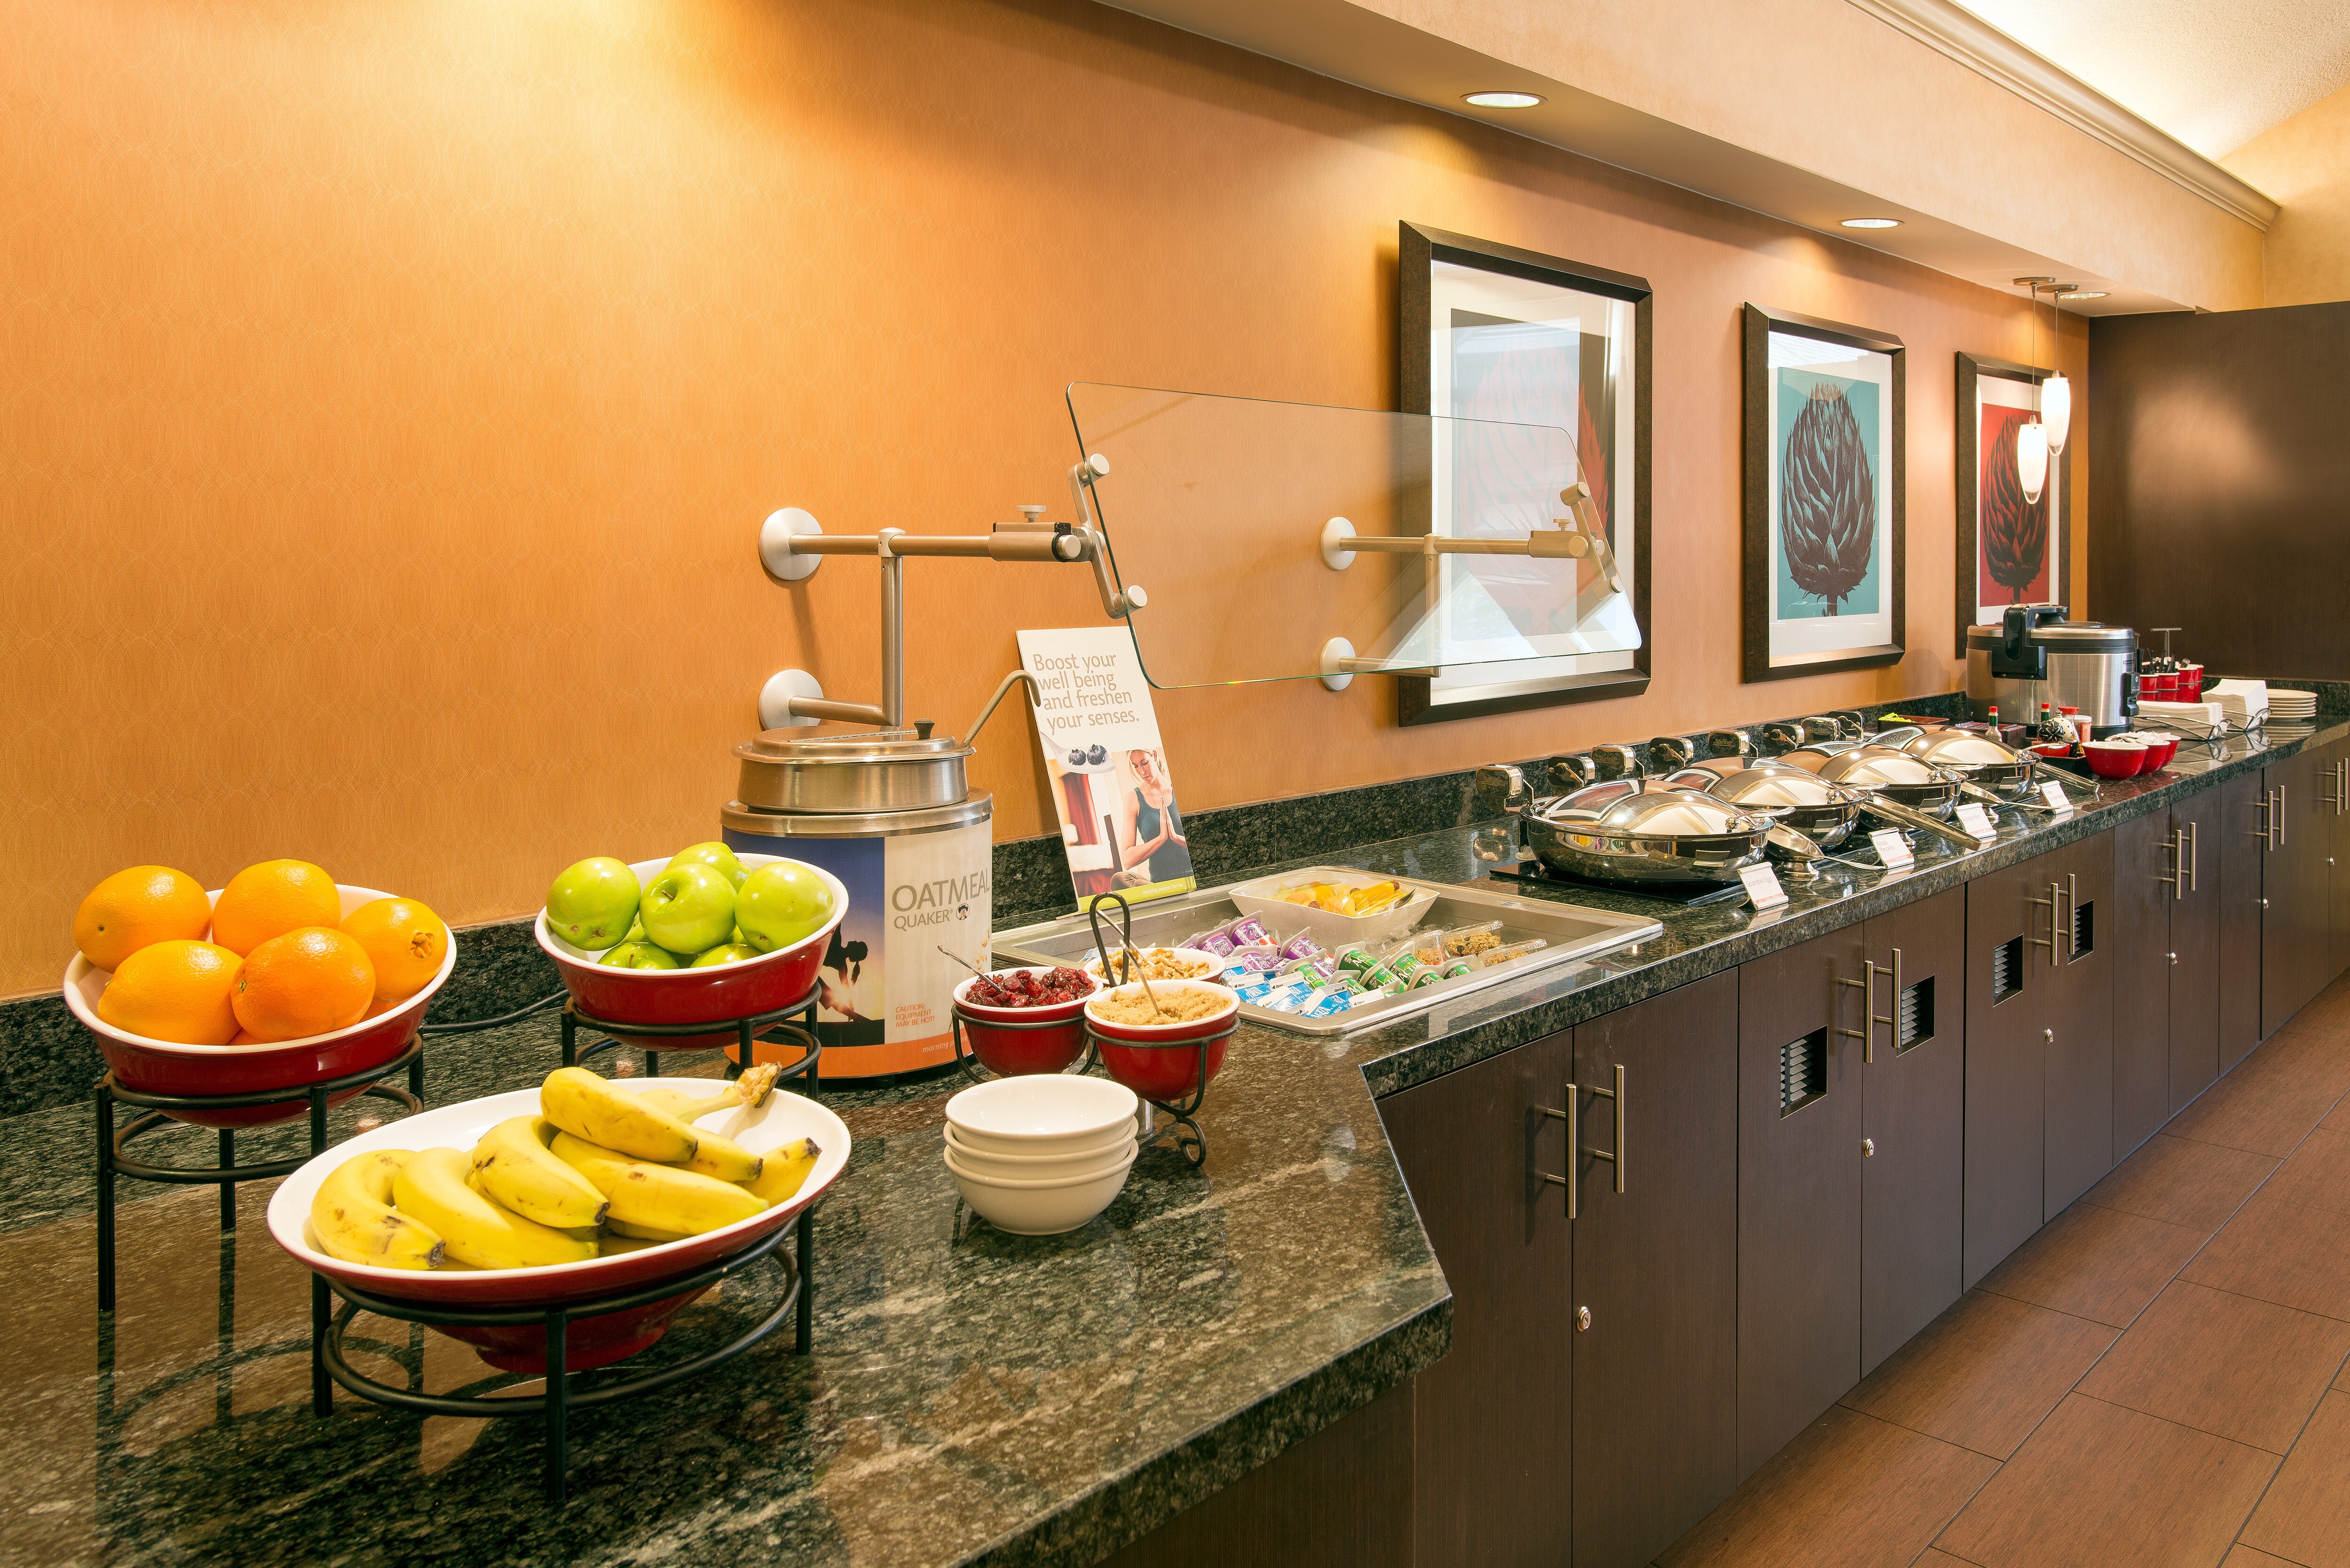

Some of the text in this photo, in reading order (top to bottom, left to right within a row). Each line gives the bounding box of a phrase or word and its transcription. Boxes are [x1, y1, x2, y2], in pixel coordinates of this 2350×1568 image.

[1033, 654, 1116, 674] Boost your
[1037, 670, 1117, 691] well being
[1042, 687, 1133, 710] and freshen
[1046, 710, 1139, 735] your senses.
[1746, 877, 1765, 887] Scrambled
[892, 868, 990, 912] OATMEAL
[1216, 942, 1229, 953] Light
[1267, 955, 1278, 964] Light
[1352, 955, 1373, 967] ACTI
[895, 1003, 925, 1013] CAUTION:
[896, 1009, 932, 1021] EQUIPMENT
[921, 1015, 935, 1024] HOT!
[923, 1035, 968, 1053] morning pple
